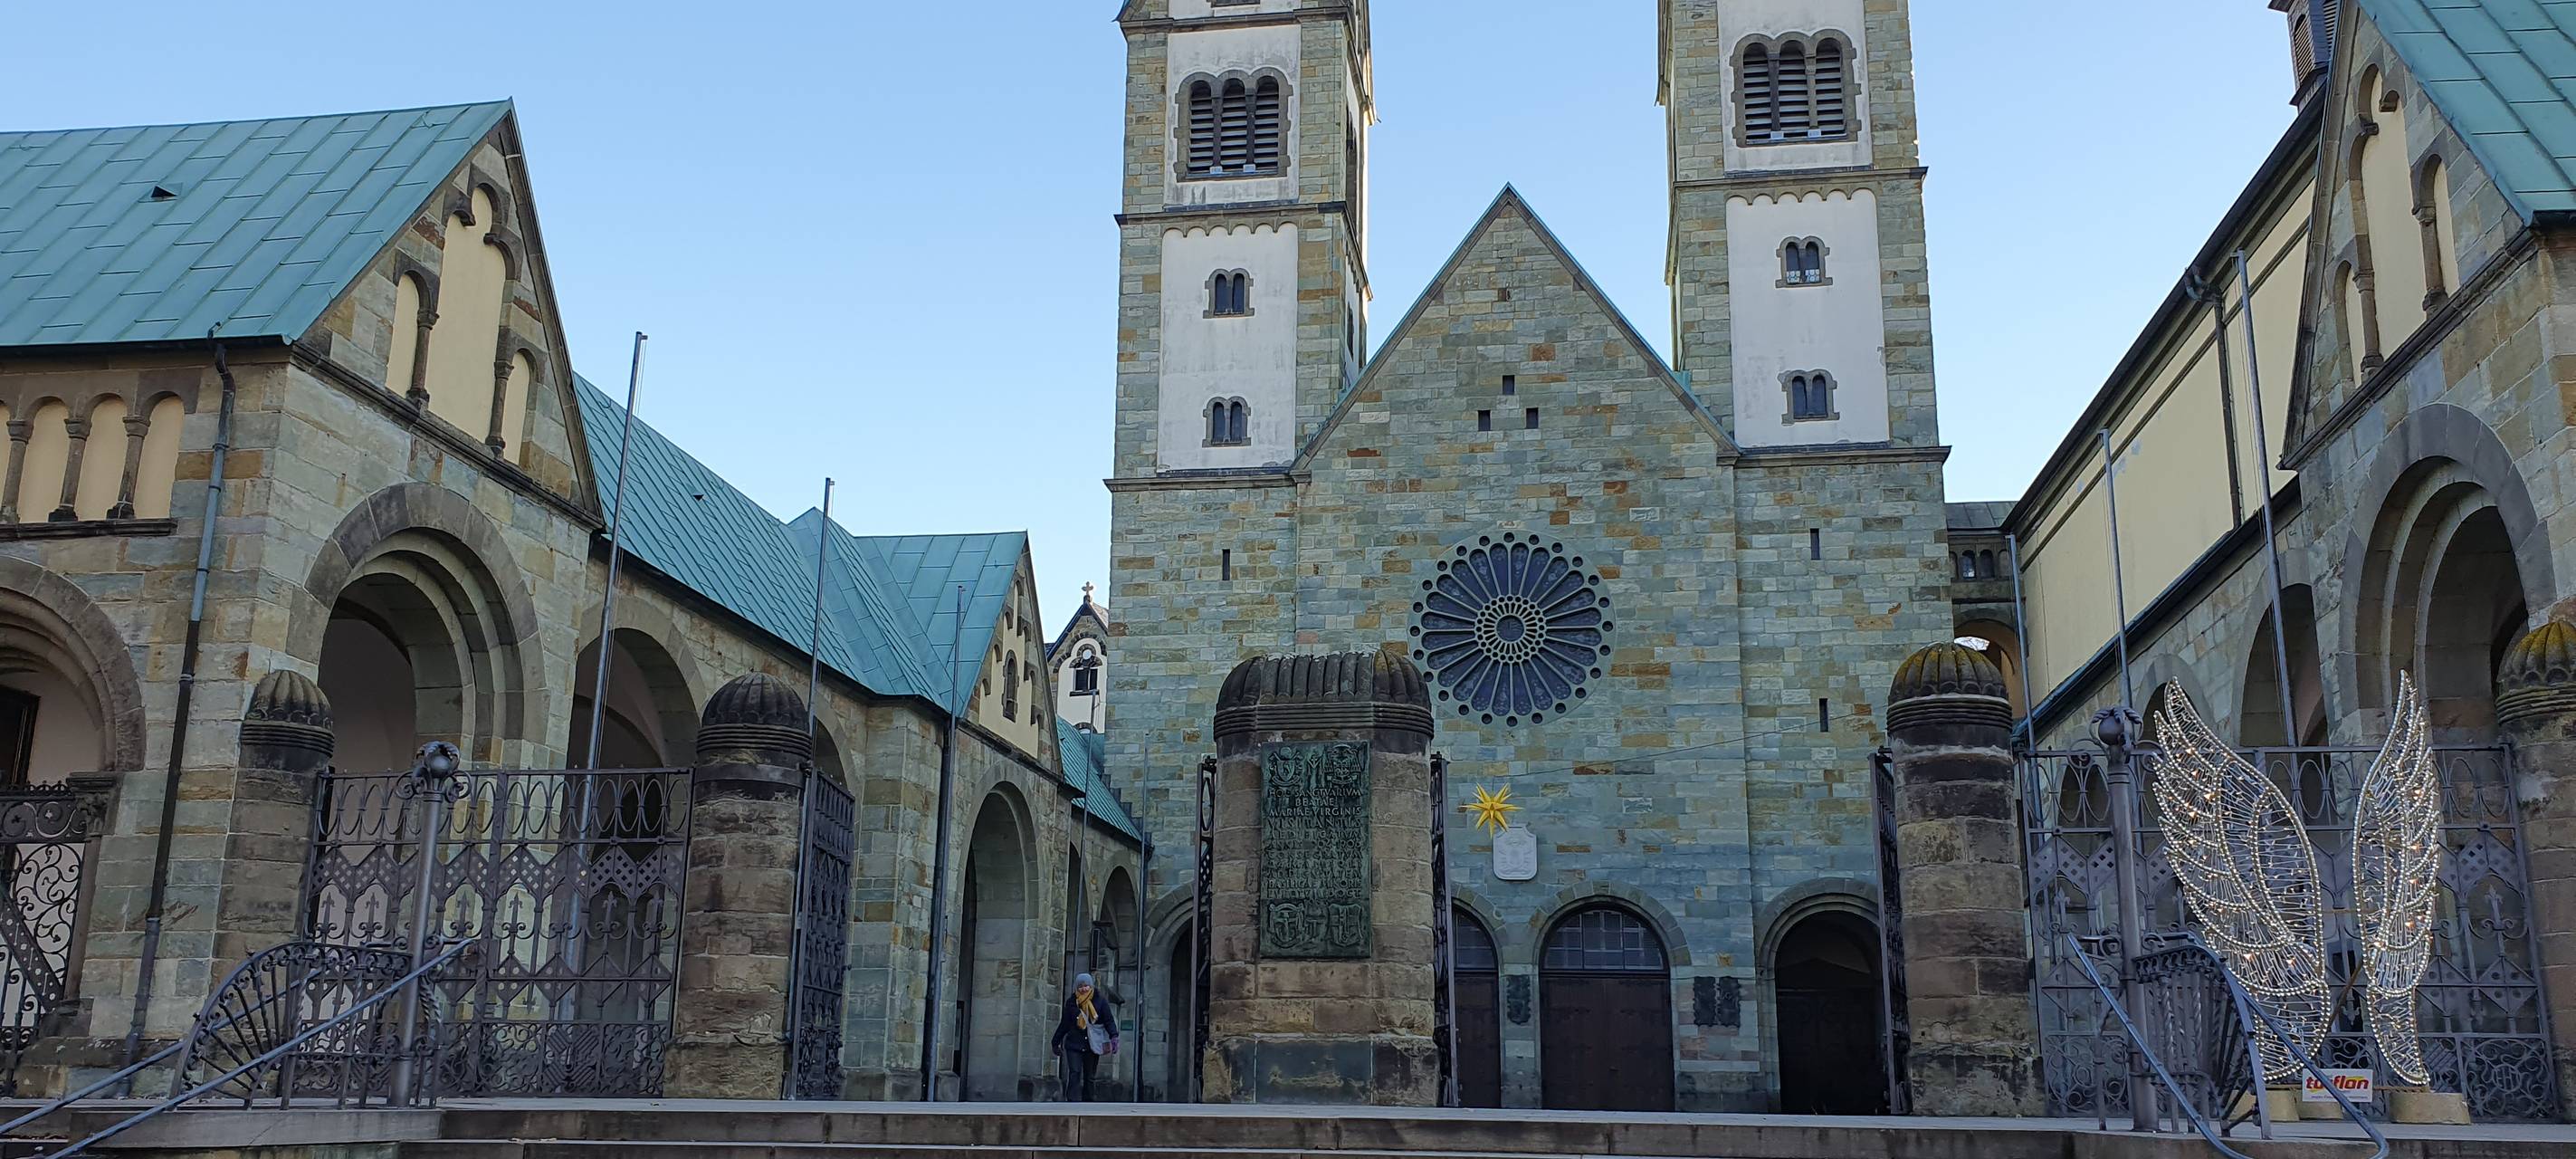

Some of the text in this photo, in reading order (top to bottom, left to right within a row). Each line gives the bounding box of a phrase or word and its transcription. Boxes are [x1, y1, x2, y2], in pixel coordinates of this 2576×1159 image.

[1268, 788, 1361, 797] HOC SANCTVARIVM
[1295, 798, 1334, 807] BEATAE
[1269, 806, 1361, 816] MARIAE VIRGINIS
[1268, 817, 1361, 828] VISITANTIS
[2305, 1076, 2370, 1089] toflon
